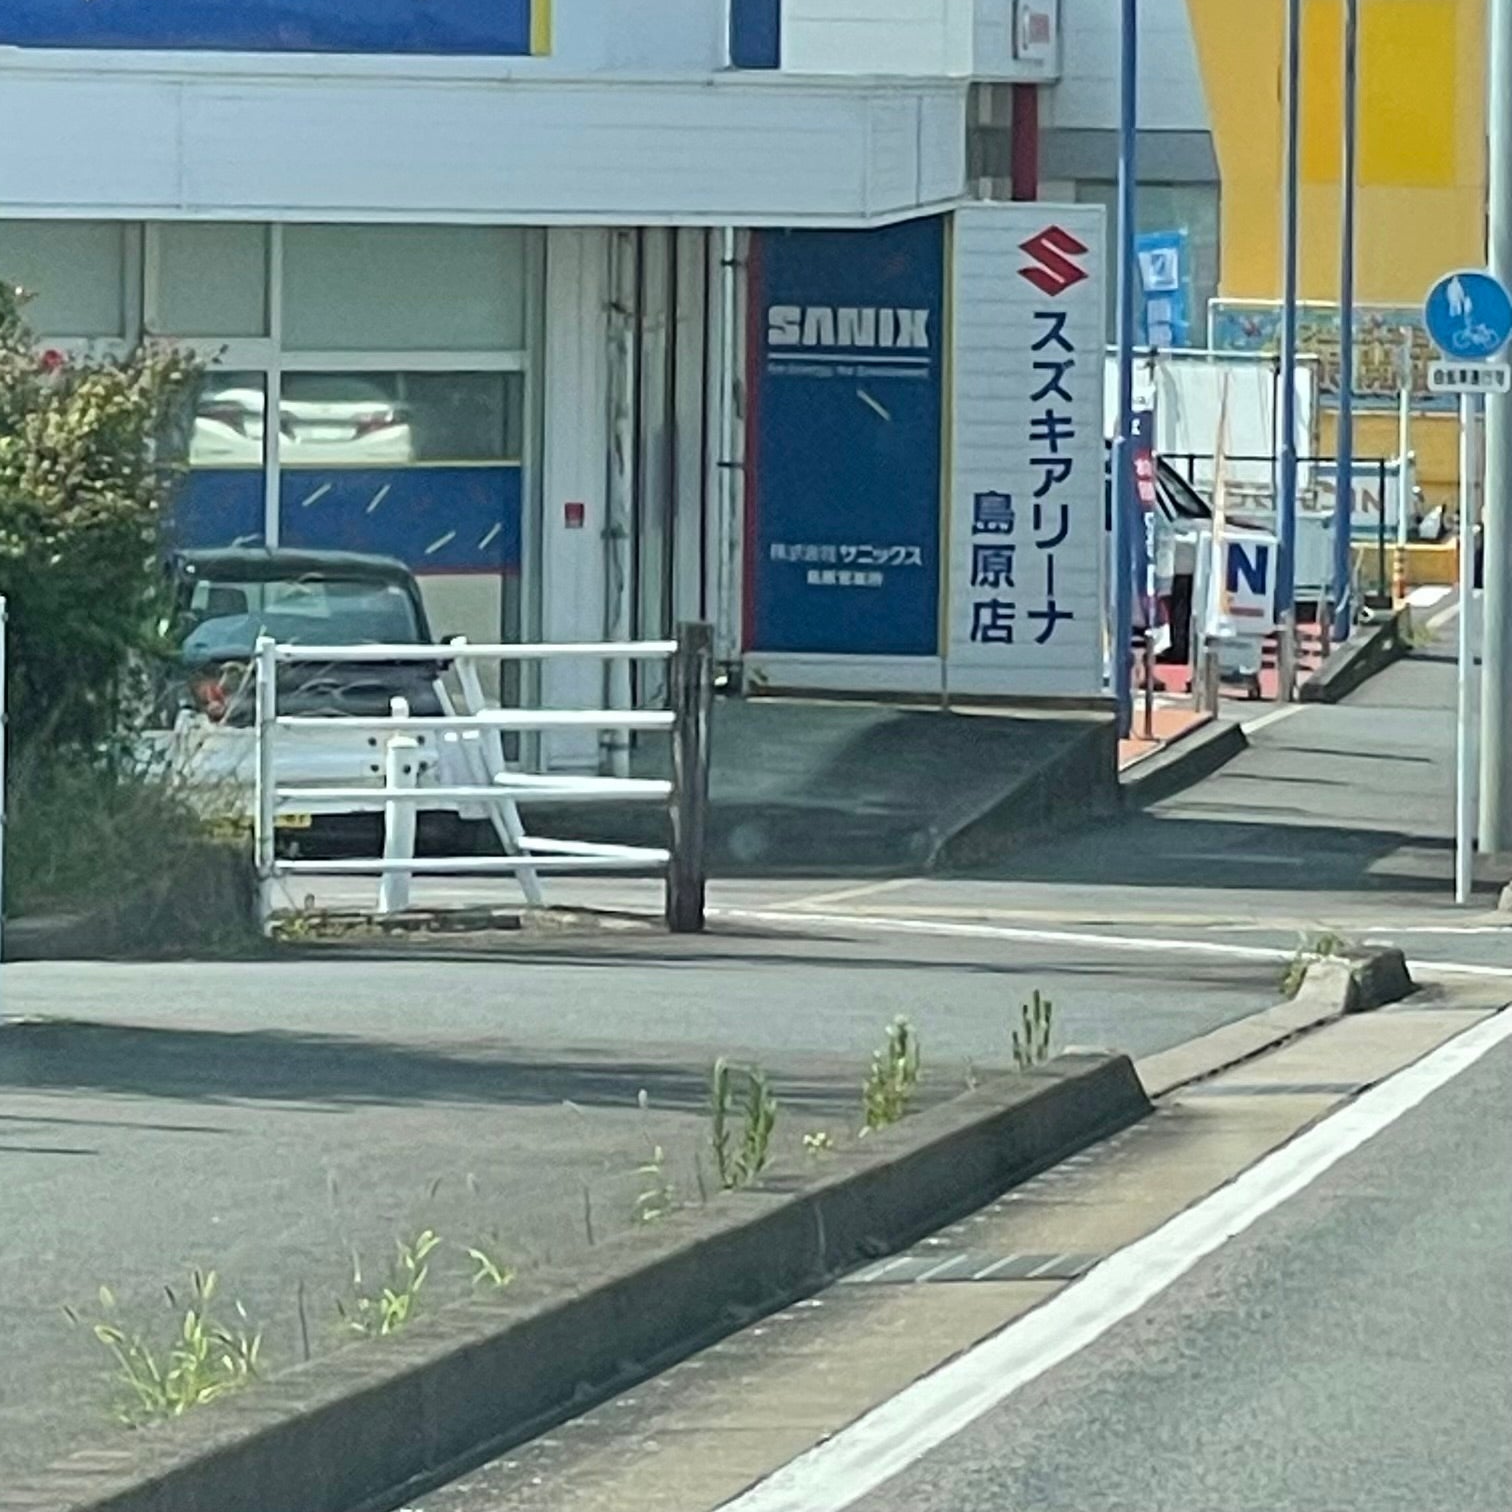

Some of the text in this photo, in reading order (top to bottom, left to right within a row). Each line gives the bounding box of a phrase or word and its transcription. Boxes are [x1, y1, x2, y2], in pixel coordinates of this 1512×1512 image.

[767, 305, 930, 348] SANIX
[1027, 310, 1076, 645] スズキアリーナ
[971, 490, 1016, 645] 島原店
